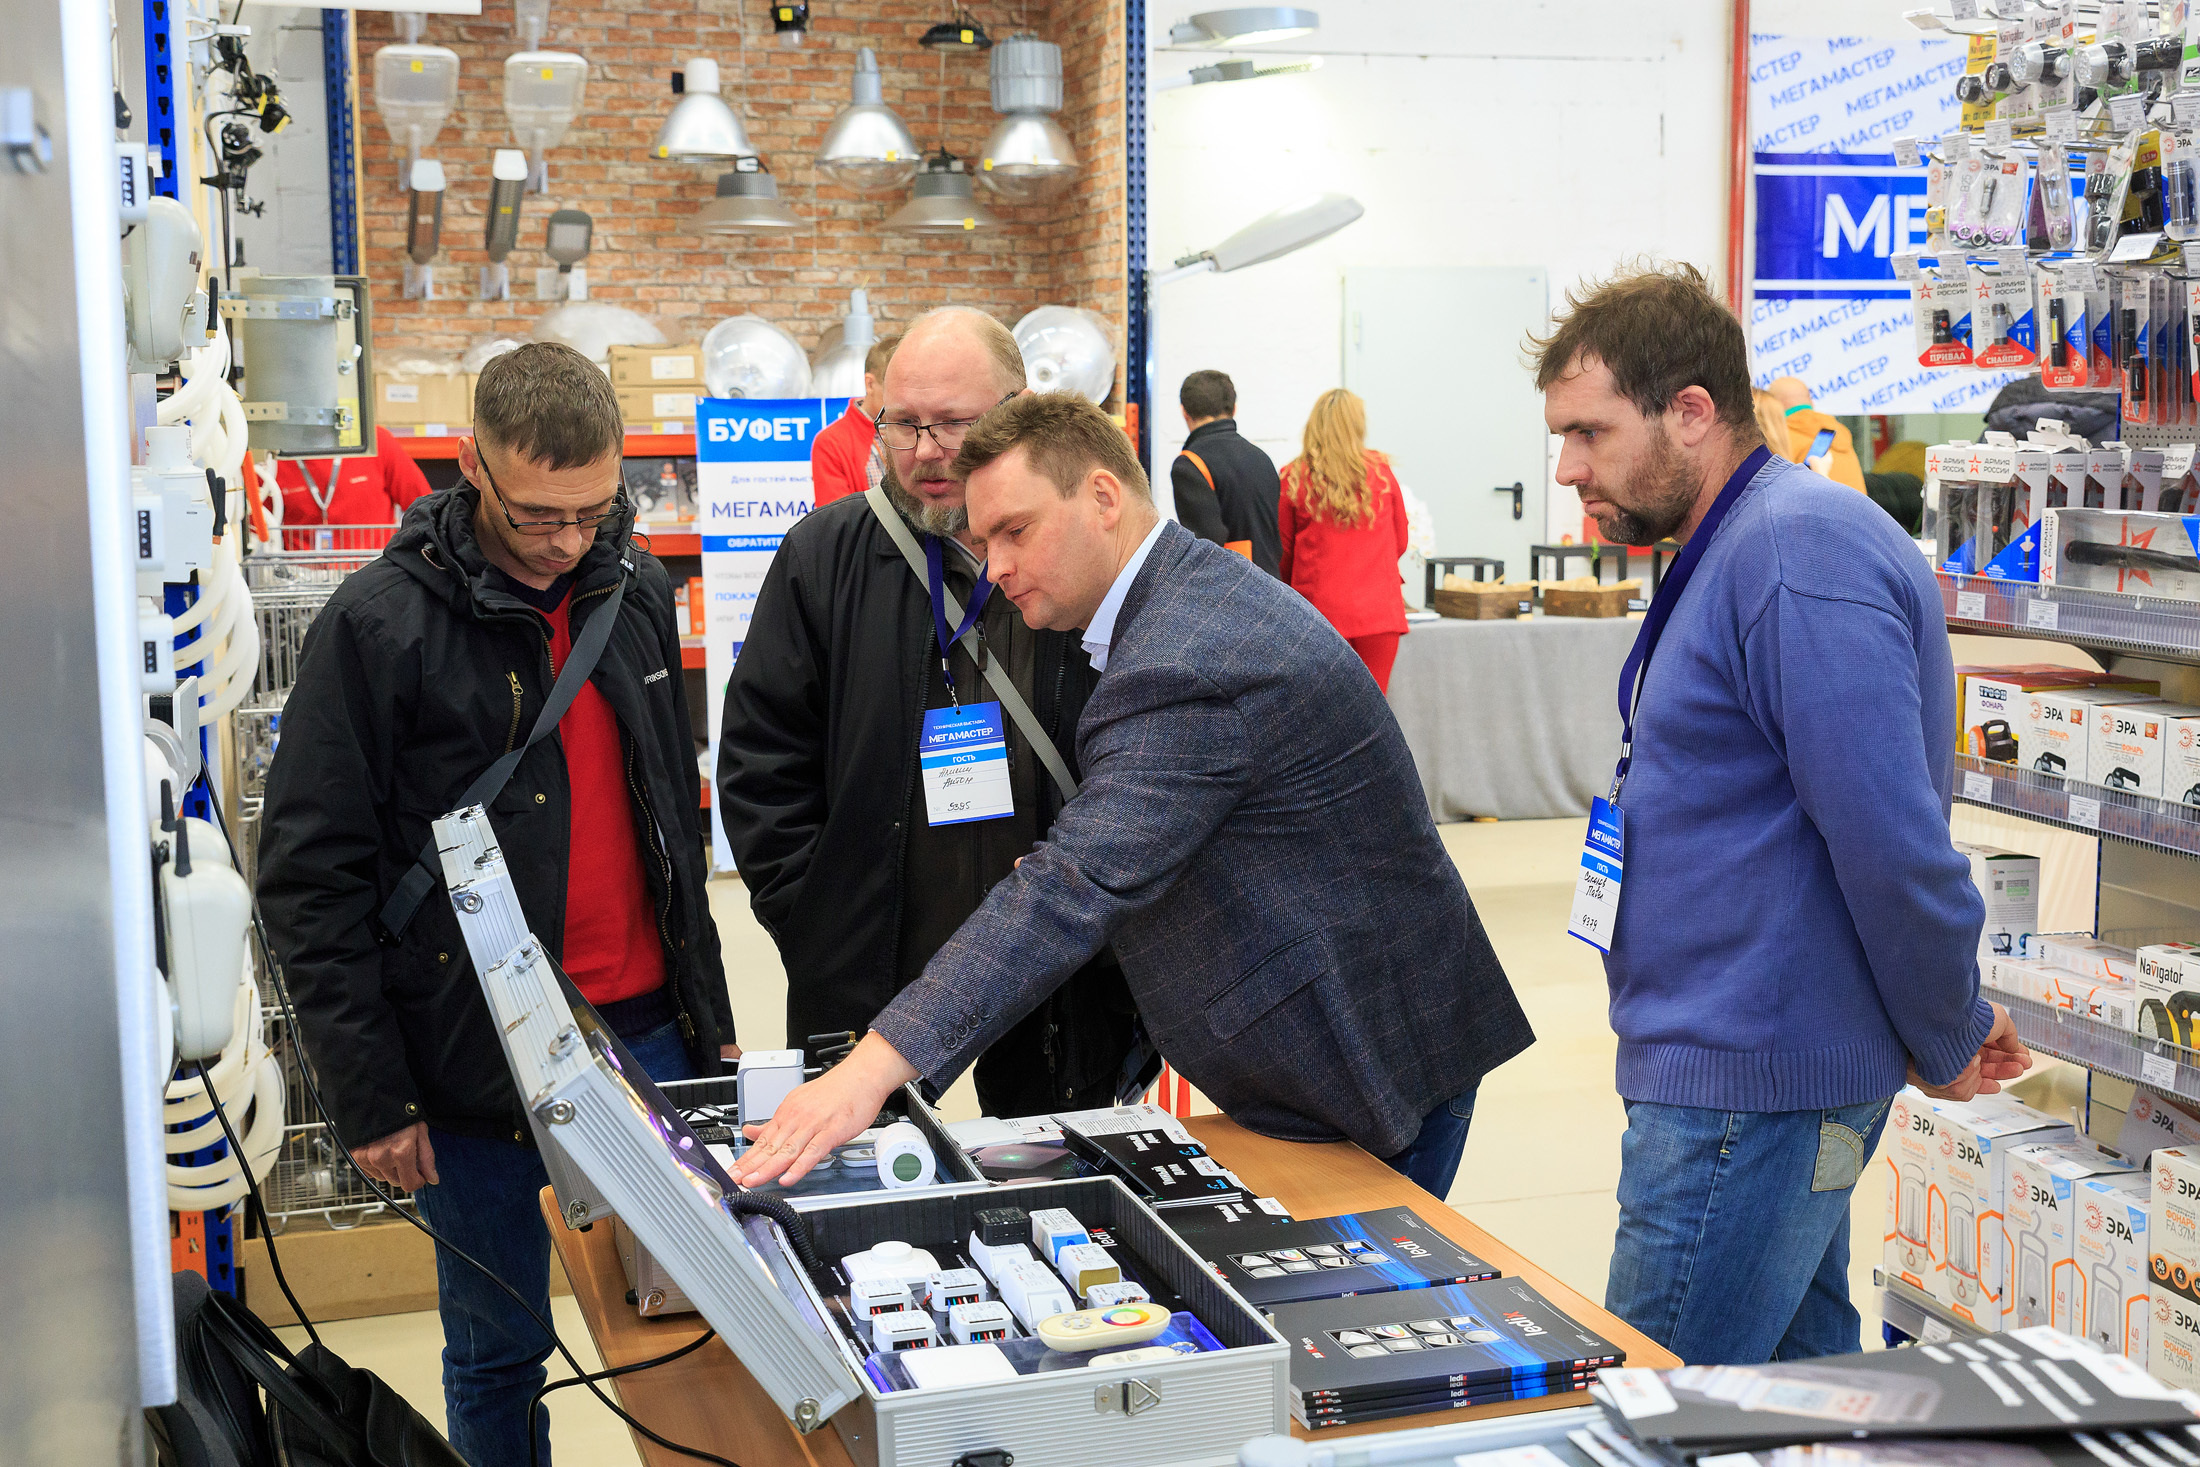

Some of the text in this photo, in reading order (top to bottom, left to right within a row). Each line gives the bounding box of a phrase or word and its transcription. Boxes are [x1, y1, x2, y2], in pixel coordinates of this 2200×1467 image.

[1769, 47, 1896, 109] МЕГАМАСТЕР
[1845, 55, 1968, 117] МЕГАМАСТЕР
[2177, 136, 2192, 148] ЭРА
[1984, 163, 1999, 172] ЭРА
[1937, 281, 1967, 290] АРМИЯ
[1995, 280, 2025, 288] АРМИЯ
[1937, 288, 1968, 296] РОССИИ
[1995, 287, 2026, 296] РОССИИ
[1754, 298, 1873, 358] МЕГАМАСТЕР
[1930, 352, 1966, 362] ПРИВАЛ
[1986, 354, 2024, 365] СНАЙПЕР
[708, 417, 811, 442] БУФЕТ
[1984, 456, 2010, 466] АРМИЯ
[1983, 465, 2010, 475] РОССИИ
[753, 475, 787, 483] гостей
[1981, 700, 2005, 710] ФОНАРЬ
[2044, 706, 2063, 721] ЭРА
[933, 722, 963, 730] ТЕХНИЧЕСКАЯ
[2116, 720, 2137, 736] ЭРА
[928, 727, 994, 743] МЕГАМАСТЕР
[2049, 729, 2069, 739] ФОНАРЬ
[2121, 744, 2144, 754] ФОНАРЬ
[952, 754, 976, 763] ГОСТЬ
[1591, 829, 1621, 850] МЕГАМАСТЕР
[1596, 862, 1609, 874] ГОСТЬ
[2140, 956, 2183, 985] Navigator
[2152, 1109, 2175, 1134] ЭРА
[1957, 1142, 1984, 1168] ЭРА
[1947, 1164, 1975, 1184] ФОНАРЬ
[2031, 1186, 2058, 1211] ЭРА
[2165, 1208, 2196, 1230] ФОНАРЬ
[2106, 1217, 2133, 1244] ЭРА
[1090, 1228, 1118, 1247] ledix
[1391, 1236, 1432, 1259] ledix
[2079, 1234, 2106, 1255] ФОНАРЬ
[2056, 1291, 2065, 1303] 40
[1503, 1310, 1548, 1337] ledix
[2131, 1328, 2139, 1340] 40
[2163, 1340, 2193, 1362] ФОНАРЬ
[1450, 1374, 1467, 1382] ledix
[1451, 1389, 1468, 1398] ledix
[1453, 1400, 1471, 1408] ledix
